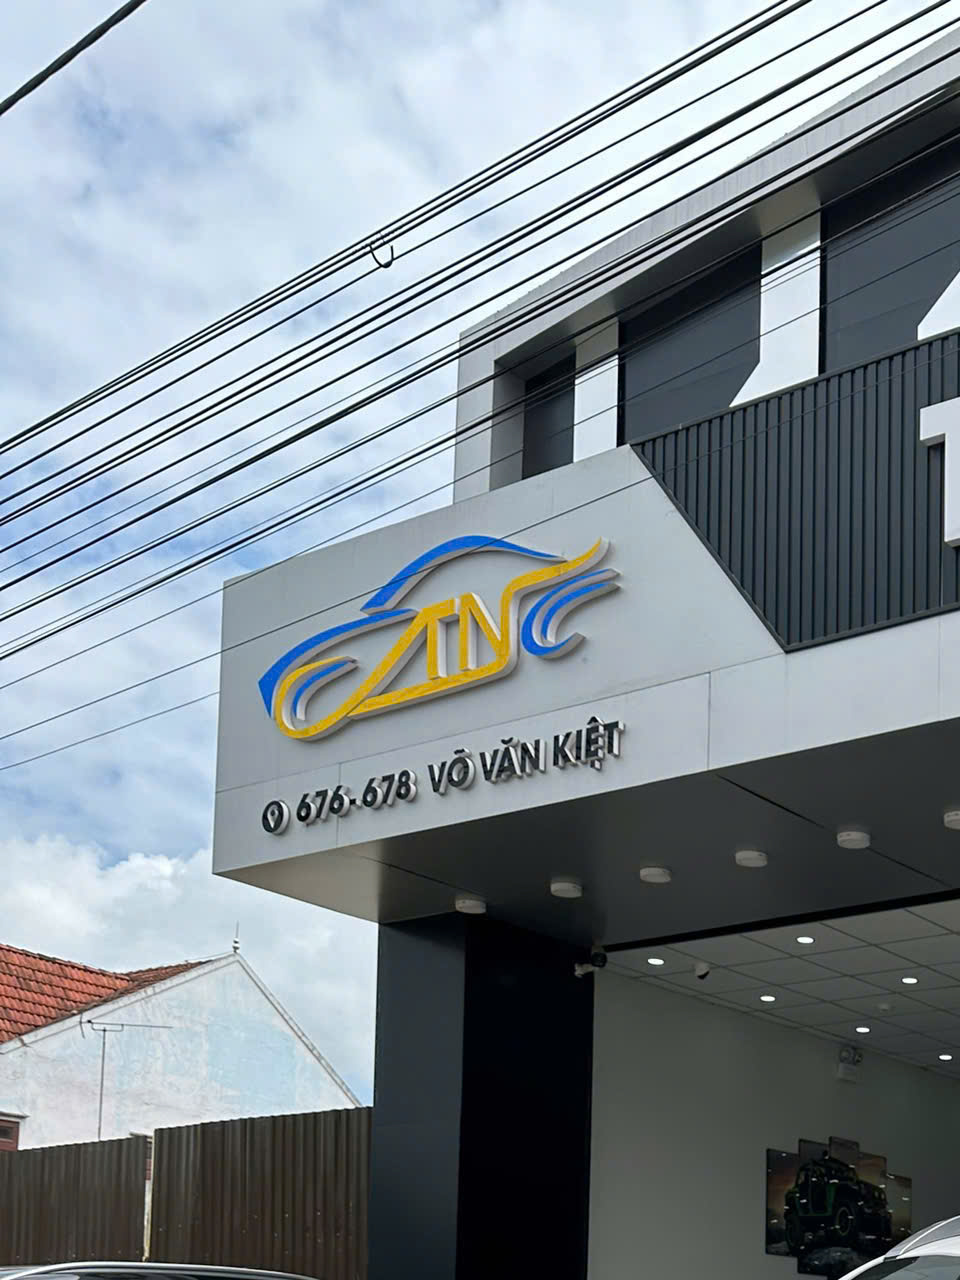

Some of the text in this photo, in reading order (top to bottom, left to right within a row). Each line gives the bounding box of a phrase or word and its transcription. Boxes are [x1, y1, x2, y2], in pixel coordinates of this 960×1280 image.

[296, 716, 626, 825] 676-678 VÕ VĂN KIỆT
